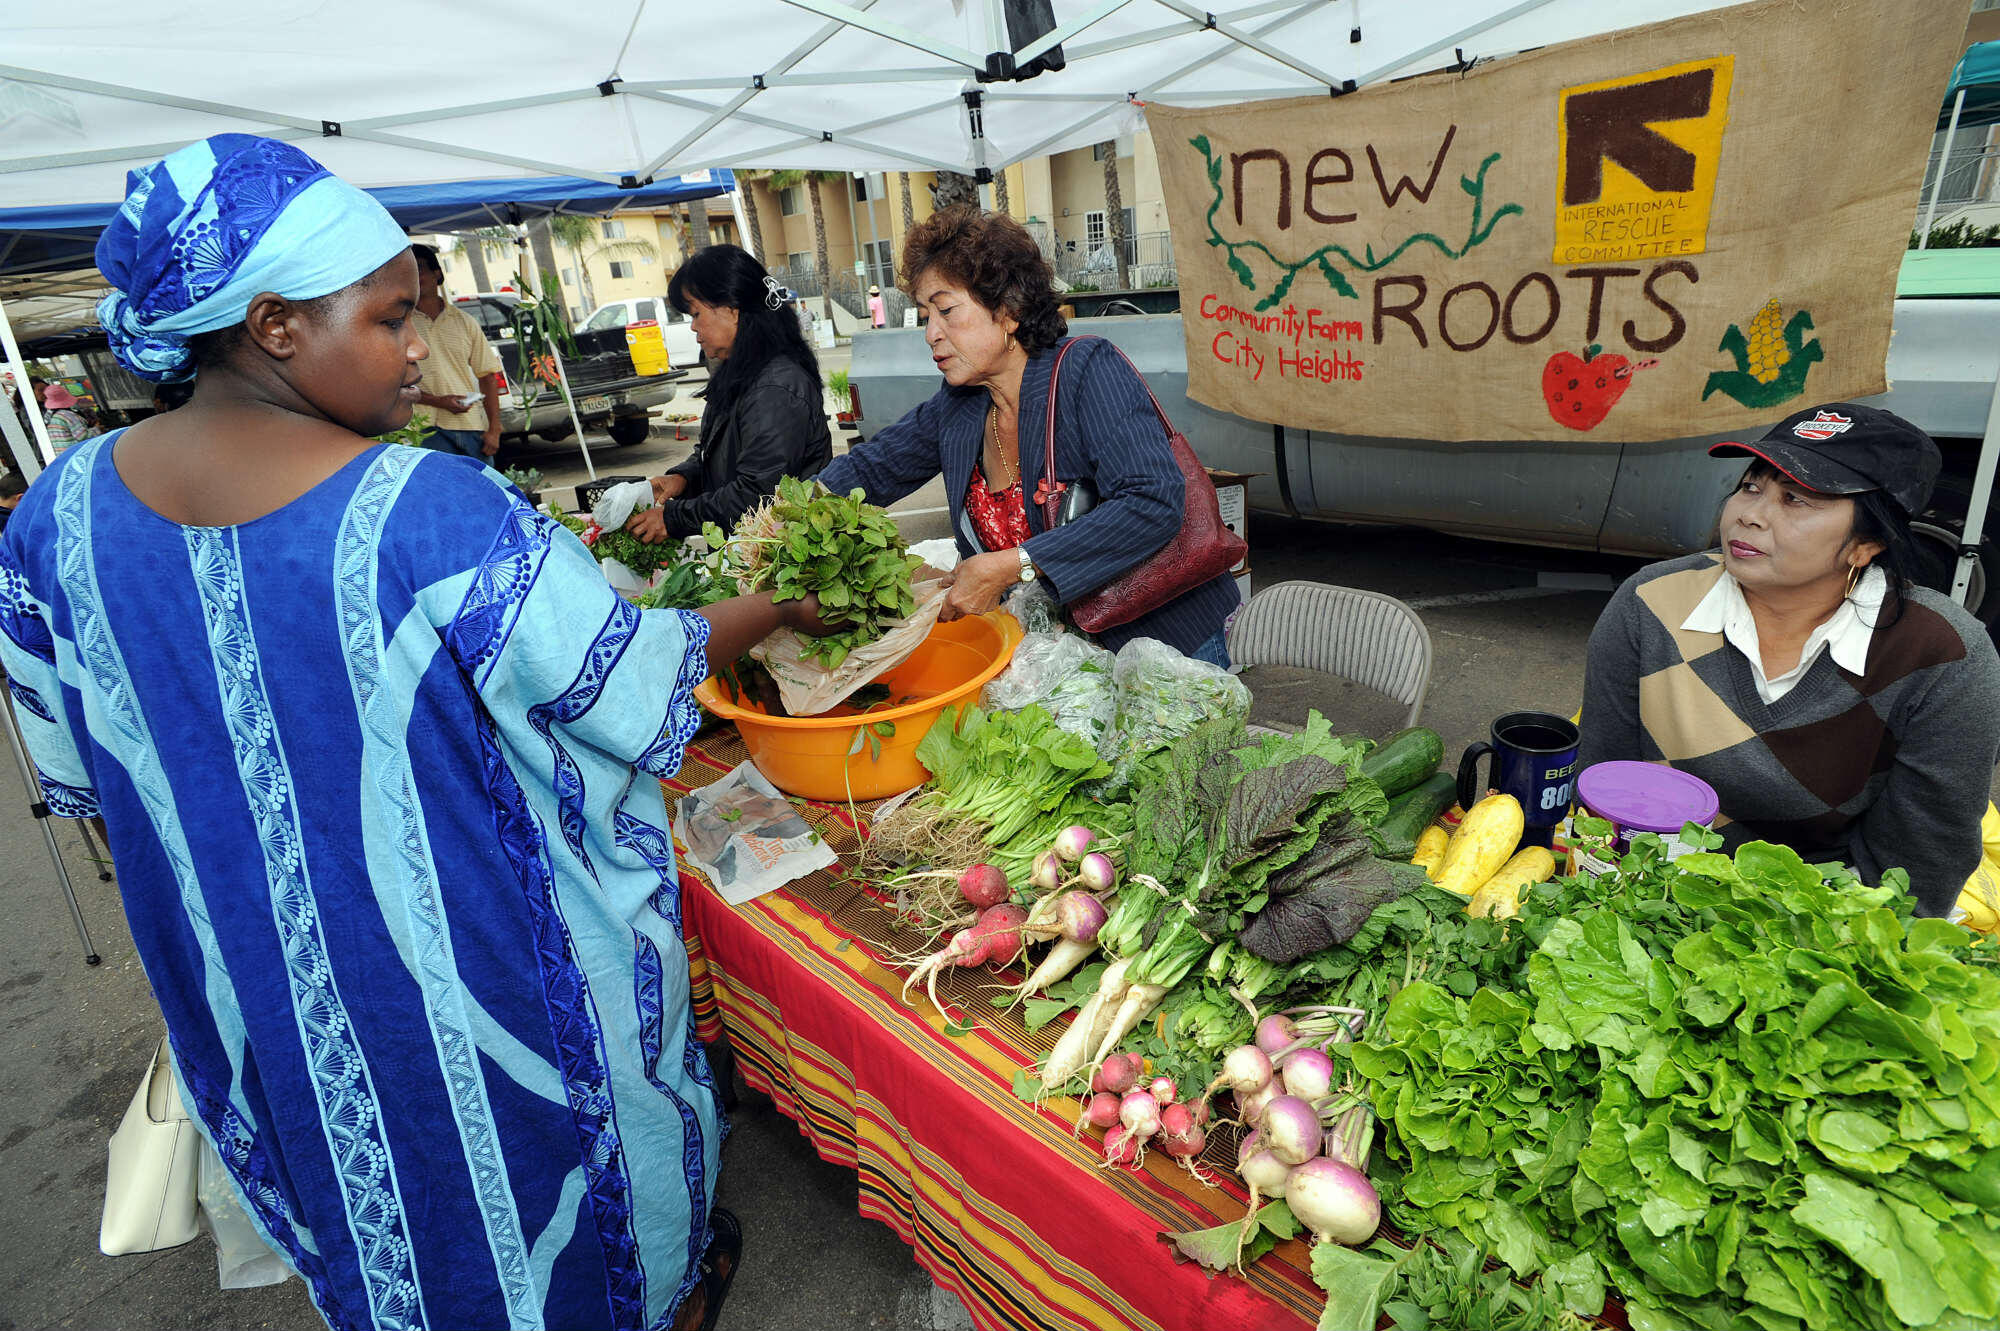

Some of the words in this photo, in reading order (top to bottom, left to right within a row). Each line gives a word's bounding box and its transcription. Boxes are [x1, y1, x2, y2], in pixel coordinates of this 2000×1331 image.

[1230, 124, 1457, 231] new
[1564, 196, 1689, 222] INTERNATIONAL
[1584, 214, 1676, 243] RESCUE
[1564, 238, 1693, 262] COMMITTEE
[1200, 294, 1304, 347] Community
[1307, 308, 1363, 342] Farm
[1372, 260, 1700, 353] ROOTS
[1212, 330, 1265, 381] City
[1278, 346, 1365, 384] Heights
